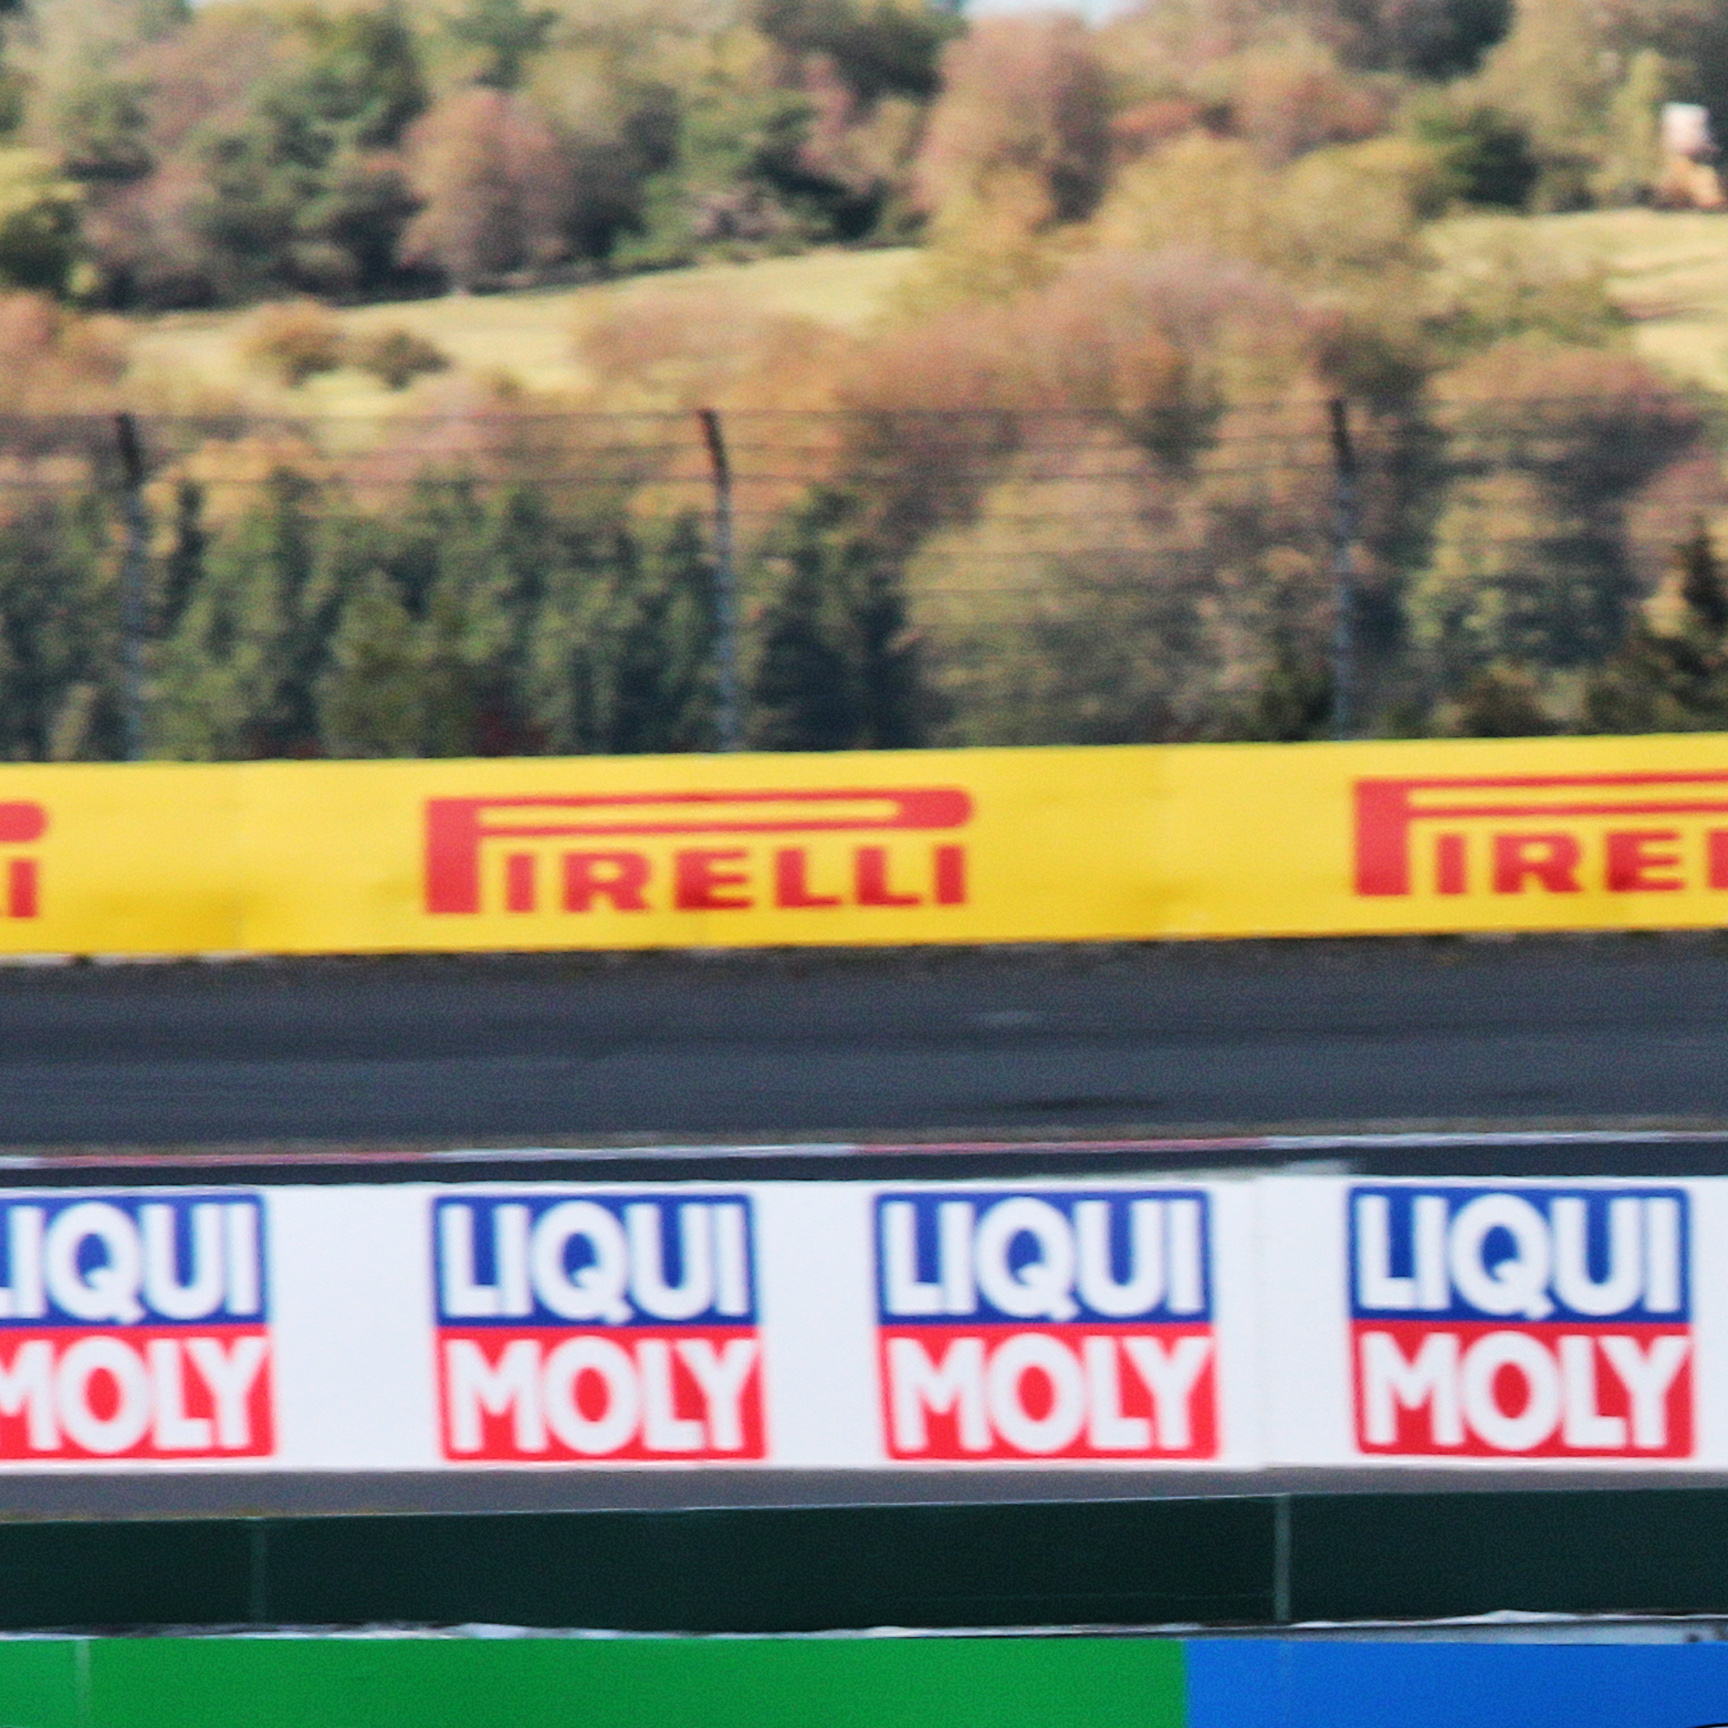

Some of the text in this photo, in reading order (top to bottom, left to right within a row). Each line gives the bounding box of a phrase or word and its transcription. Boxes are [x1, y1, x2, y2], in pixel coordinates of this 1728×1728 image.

[423, 788, 973, 915] PIRELLI
[0, 1202, 258, 1326] IQUI
[444, 1198, 751, 1325] LIQUI
[886, 1195, 1206, 1323] LIQUI
[1359, 1194, 1684, 1321] LIQUI
[446, 1334, 760, 1454] MOLY
[888, 1333, 1212, 1453] MOLY
[1360, 1330, 1688, 1451] MOLY
